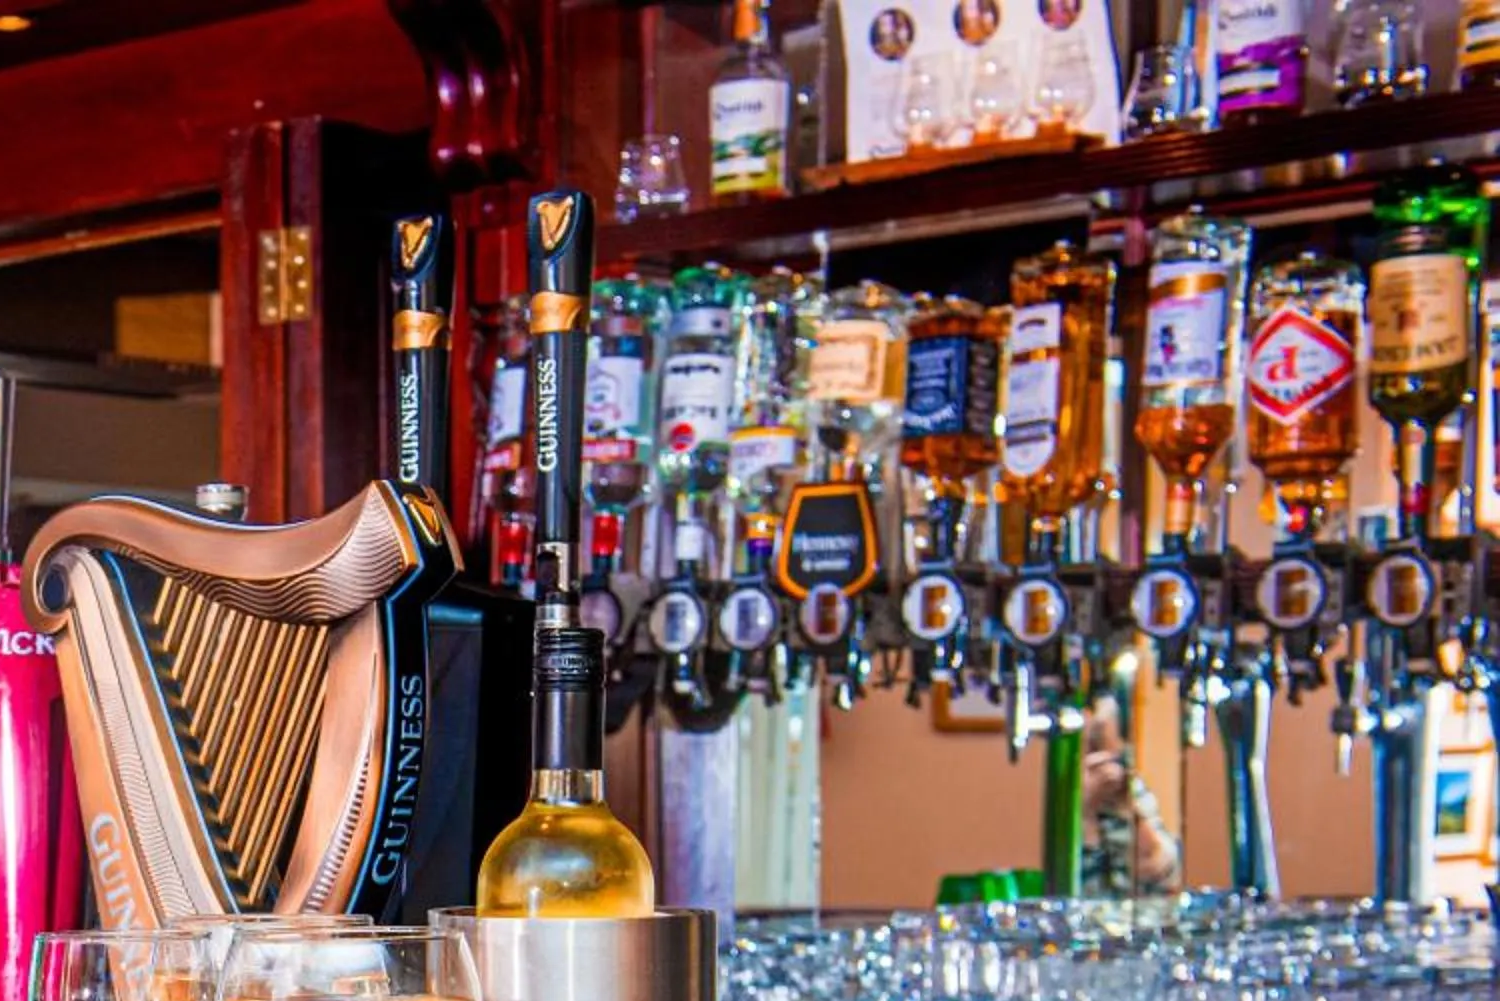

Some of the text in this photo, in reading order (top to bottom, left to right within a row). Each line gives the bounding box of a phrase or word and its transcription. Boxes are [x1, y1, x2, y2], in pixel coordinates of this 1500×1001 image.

[400, 373, 419, 483] GUINNESS
[537, 356, 557, 473] GUINNESS
[371, 674, 423, 885] GUINNESS
